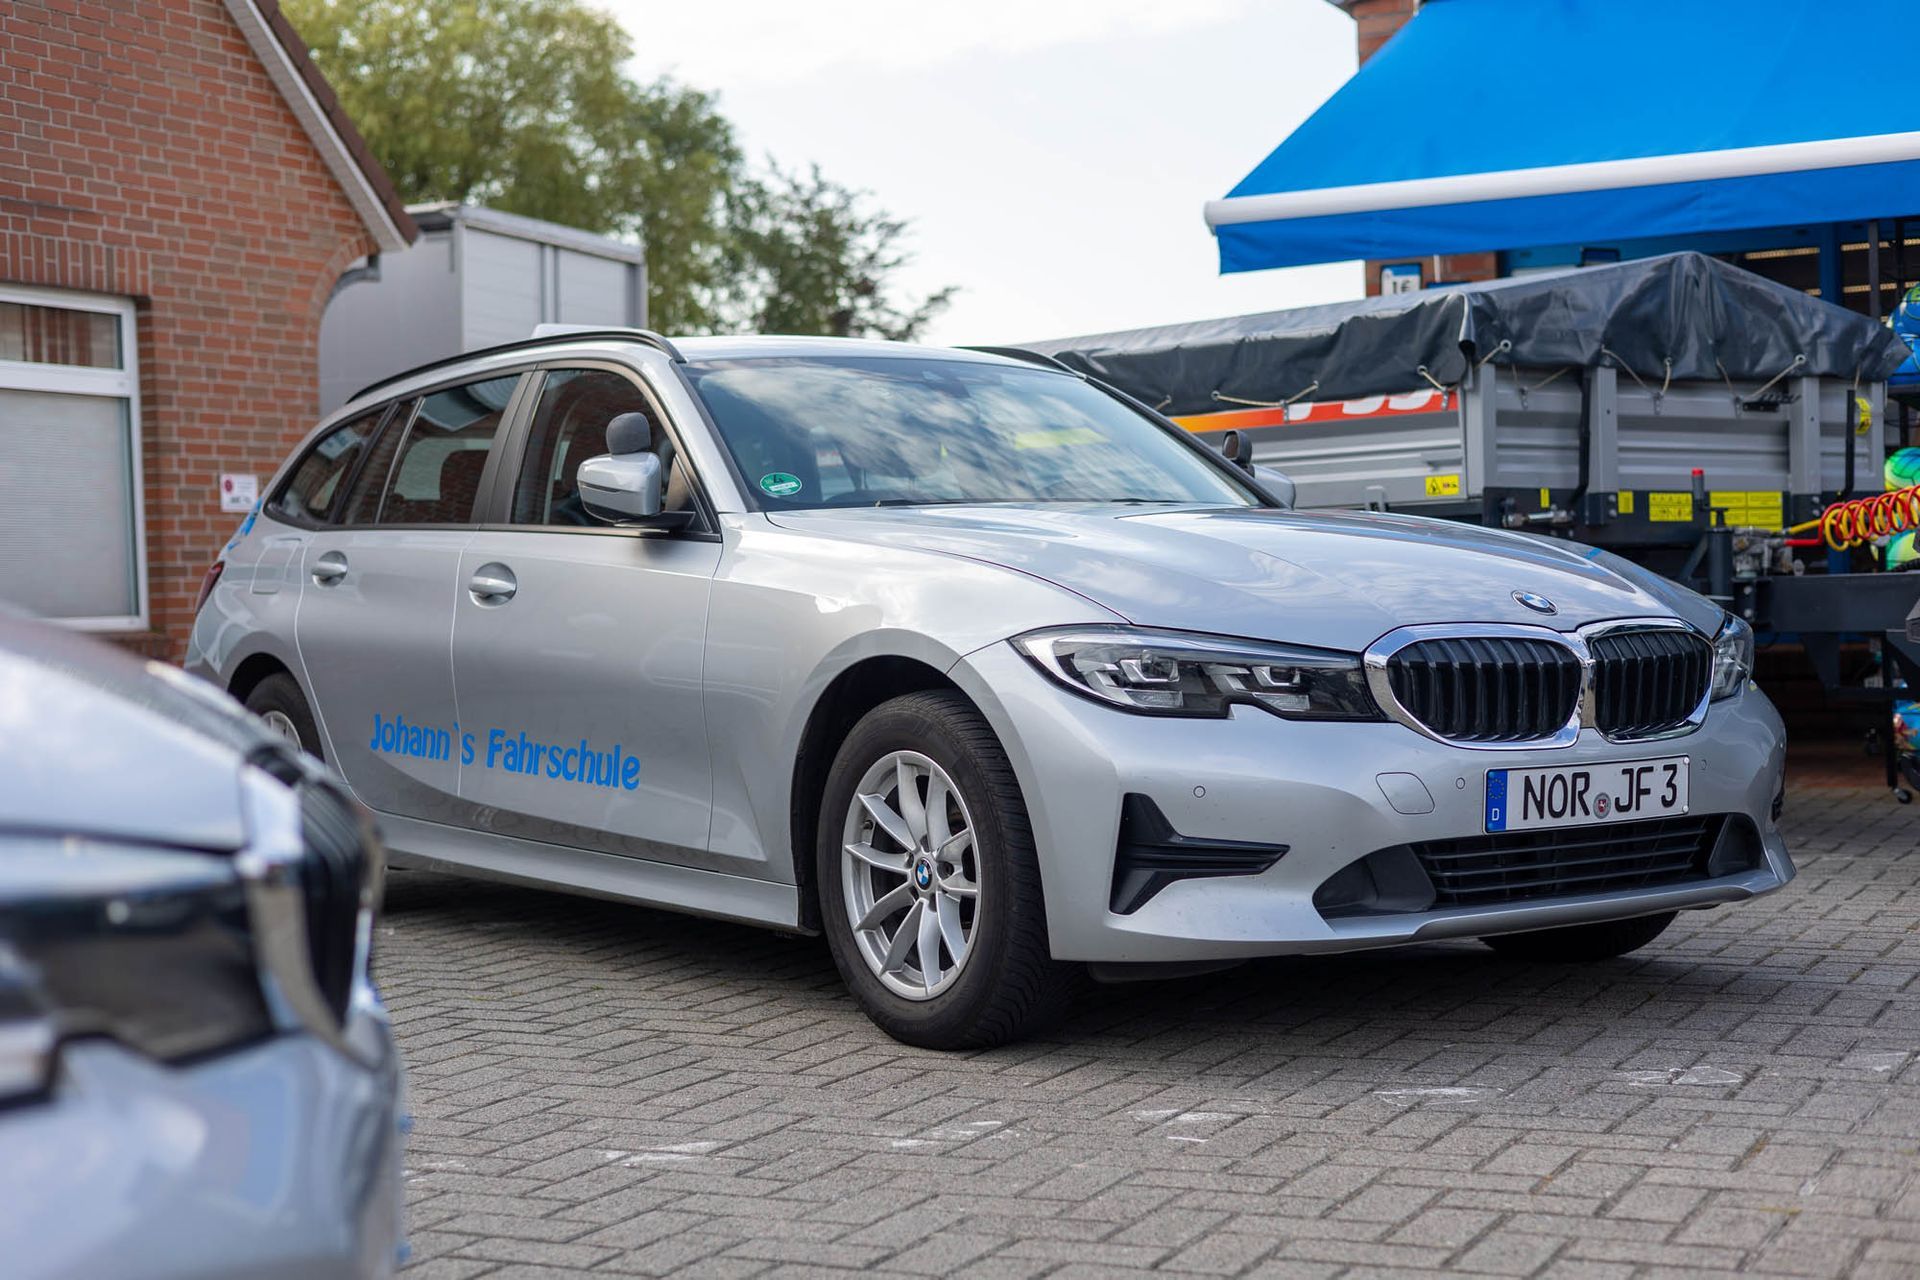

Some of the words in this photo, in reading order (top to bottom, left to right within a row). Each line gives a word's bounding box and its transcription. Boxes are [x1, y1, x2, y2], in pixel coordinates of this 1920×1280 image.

[486, 728, 640, 791] Fahrschule
[1492, 808, 1500, 821] D
[1523, 771, 1591, 821] NOR
